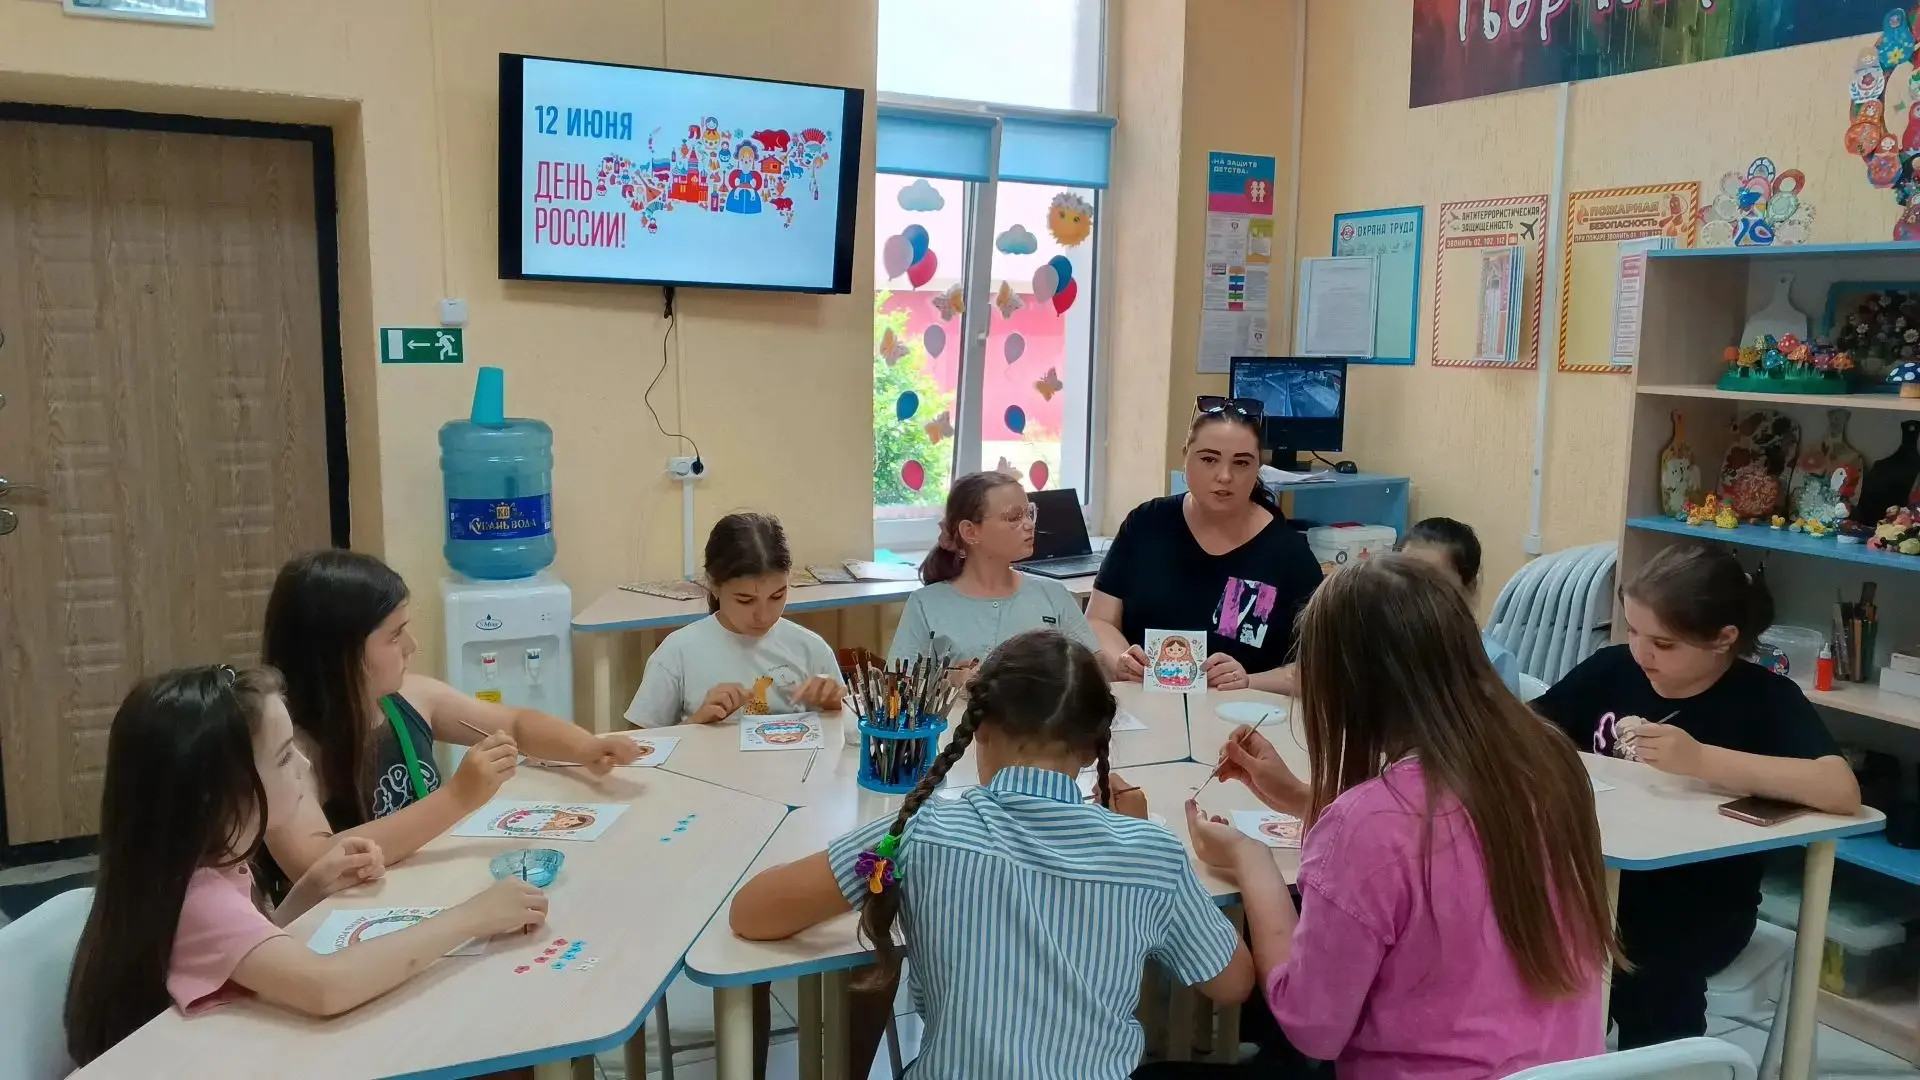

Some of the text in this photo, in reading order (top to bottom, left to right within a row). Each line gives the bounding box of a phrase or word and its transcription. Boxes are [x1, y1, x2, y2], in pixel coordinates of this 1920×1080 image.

[533, 105, 633, 141] 12 ИЮНЯ
[1227, 159, 1258, 168] ЗАЩИТЕ
[533, 160, 594, 204] ДЕНЬ
[1461, 206, 1540, 221] АНТИТЕРРОРИСТИЧЕСКАЯ
[1589, 201, 1660, 217] ПОЖАРНАЯ
[534, 207, 627, 249] РОССИИ!
[1357, 221, 1414, 237] ОХРАНА ТРУДА
[1461, 220, 1514, 232] ЗАЩИЩЕННОСТЬ
[1589, 218, 1658, 230] БЕЗОПАСНОСТЬ
[1447, 238, 1473, 247] ЗВОНИТЬ
